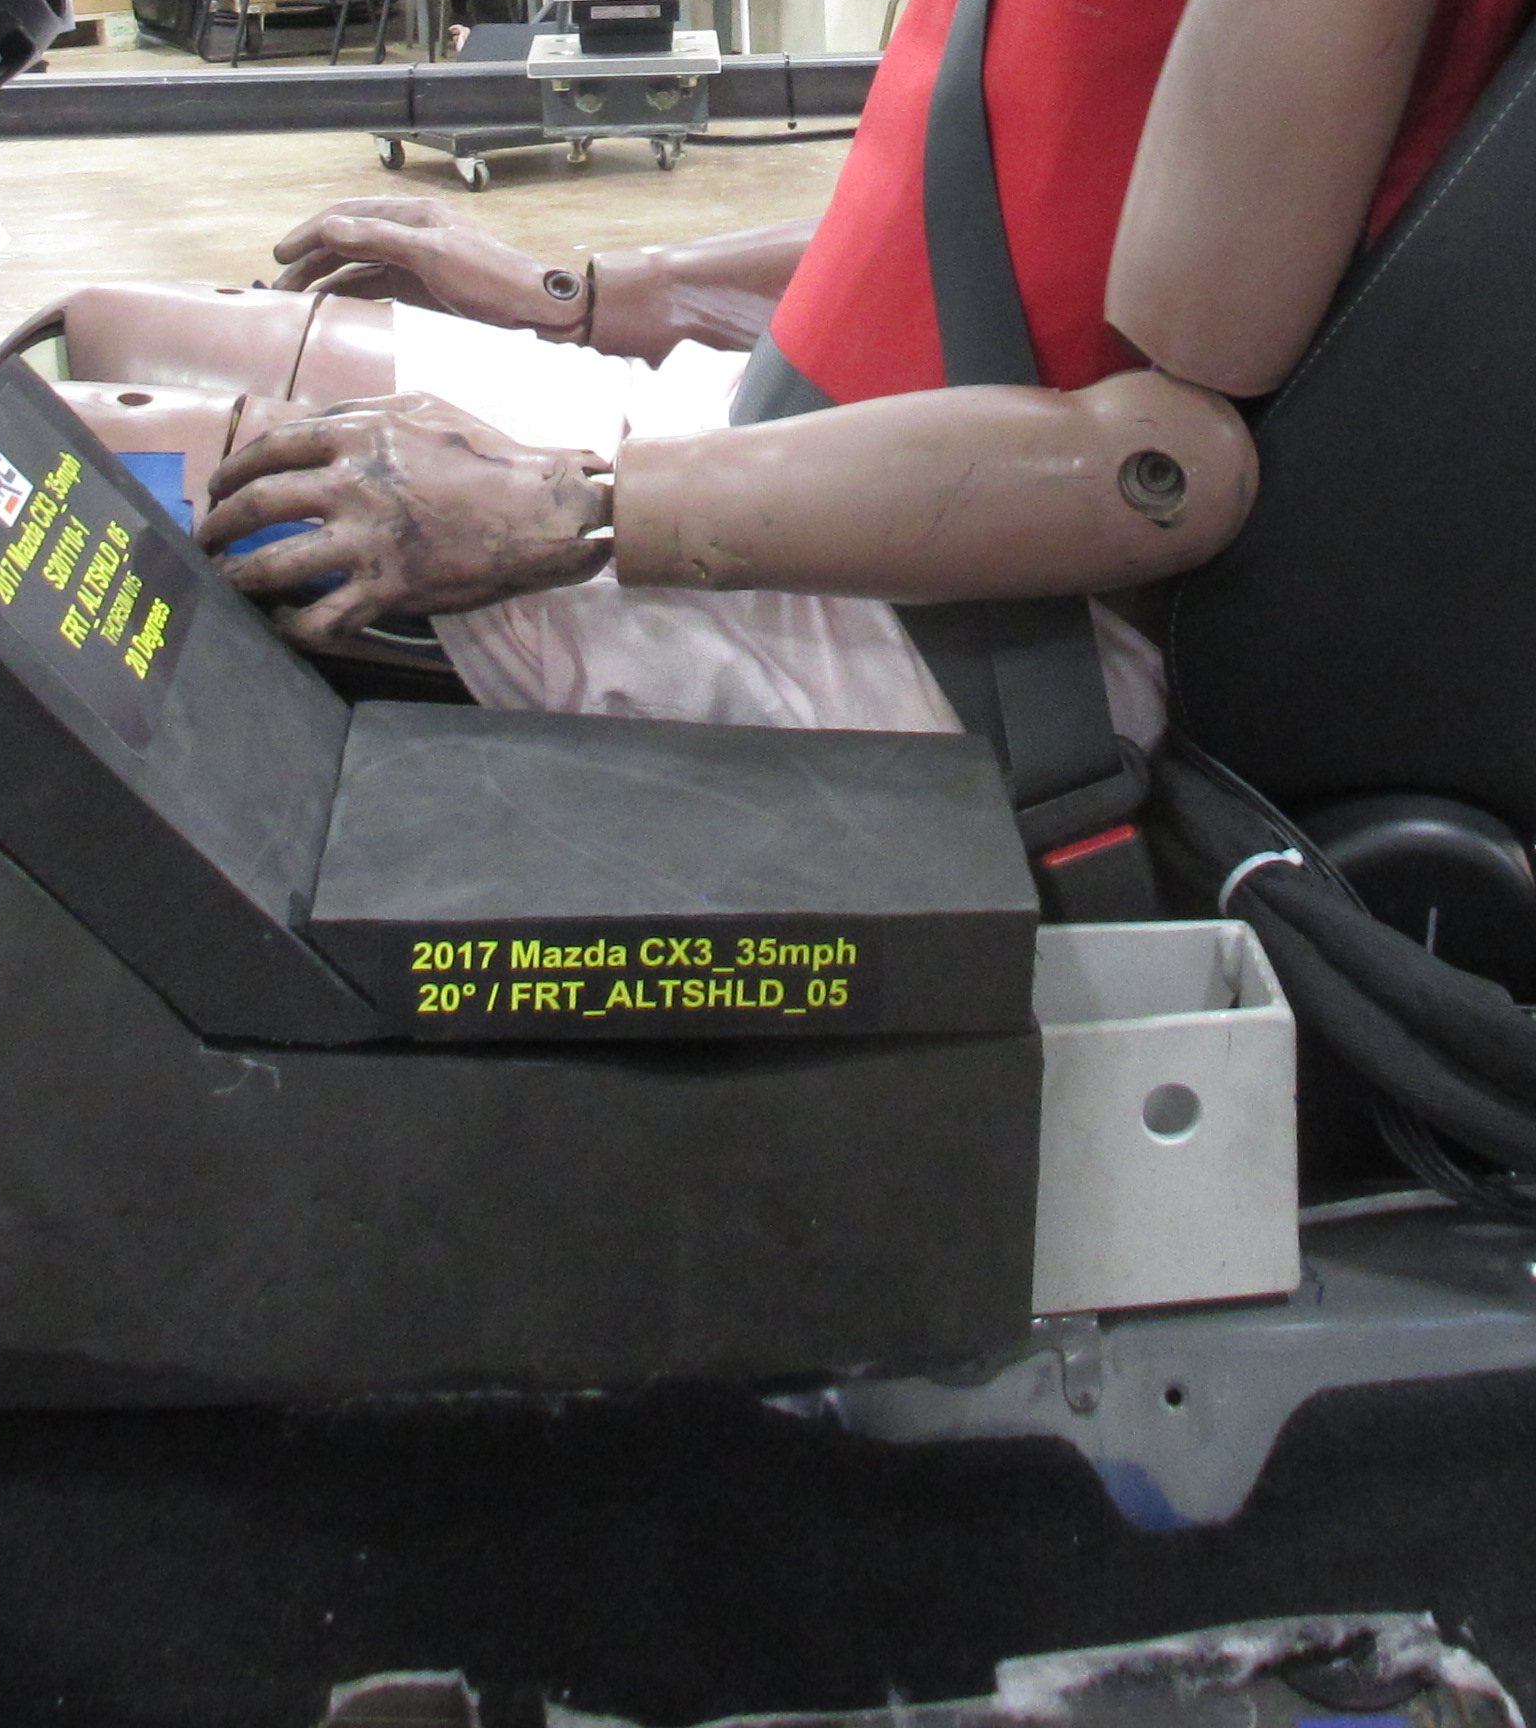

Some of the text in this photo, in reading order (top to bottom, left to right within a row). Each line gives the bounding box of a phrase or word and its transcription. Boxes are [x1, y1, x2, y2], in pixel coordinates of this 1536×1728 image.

[5, 521, 47, 572] Mazda
[29, 451, 83, 529] CX3_35mph
[42, 514, 91, 591] S201110-1
[59, 519, 131, 649] FRT_ALTSHLD_05
[124, 597, 172, 680] 20 Degrees
[411, 937, 858, 974] 2017 Mazda CX3_35mph
[417, 978, 849, 1016] 20° / FRT_ALTSHLD_05
